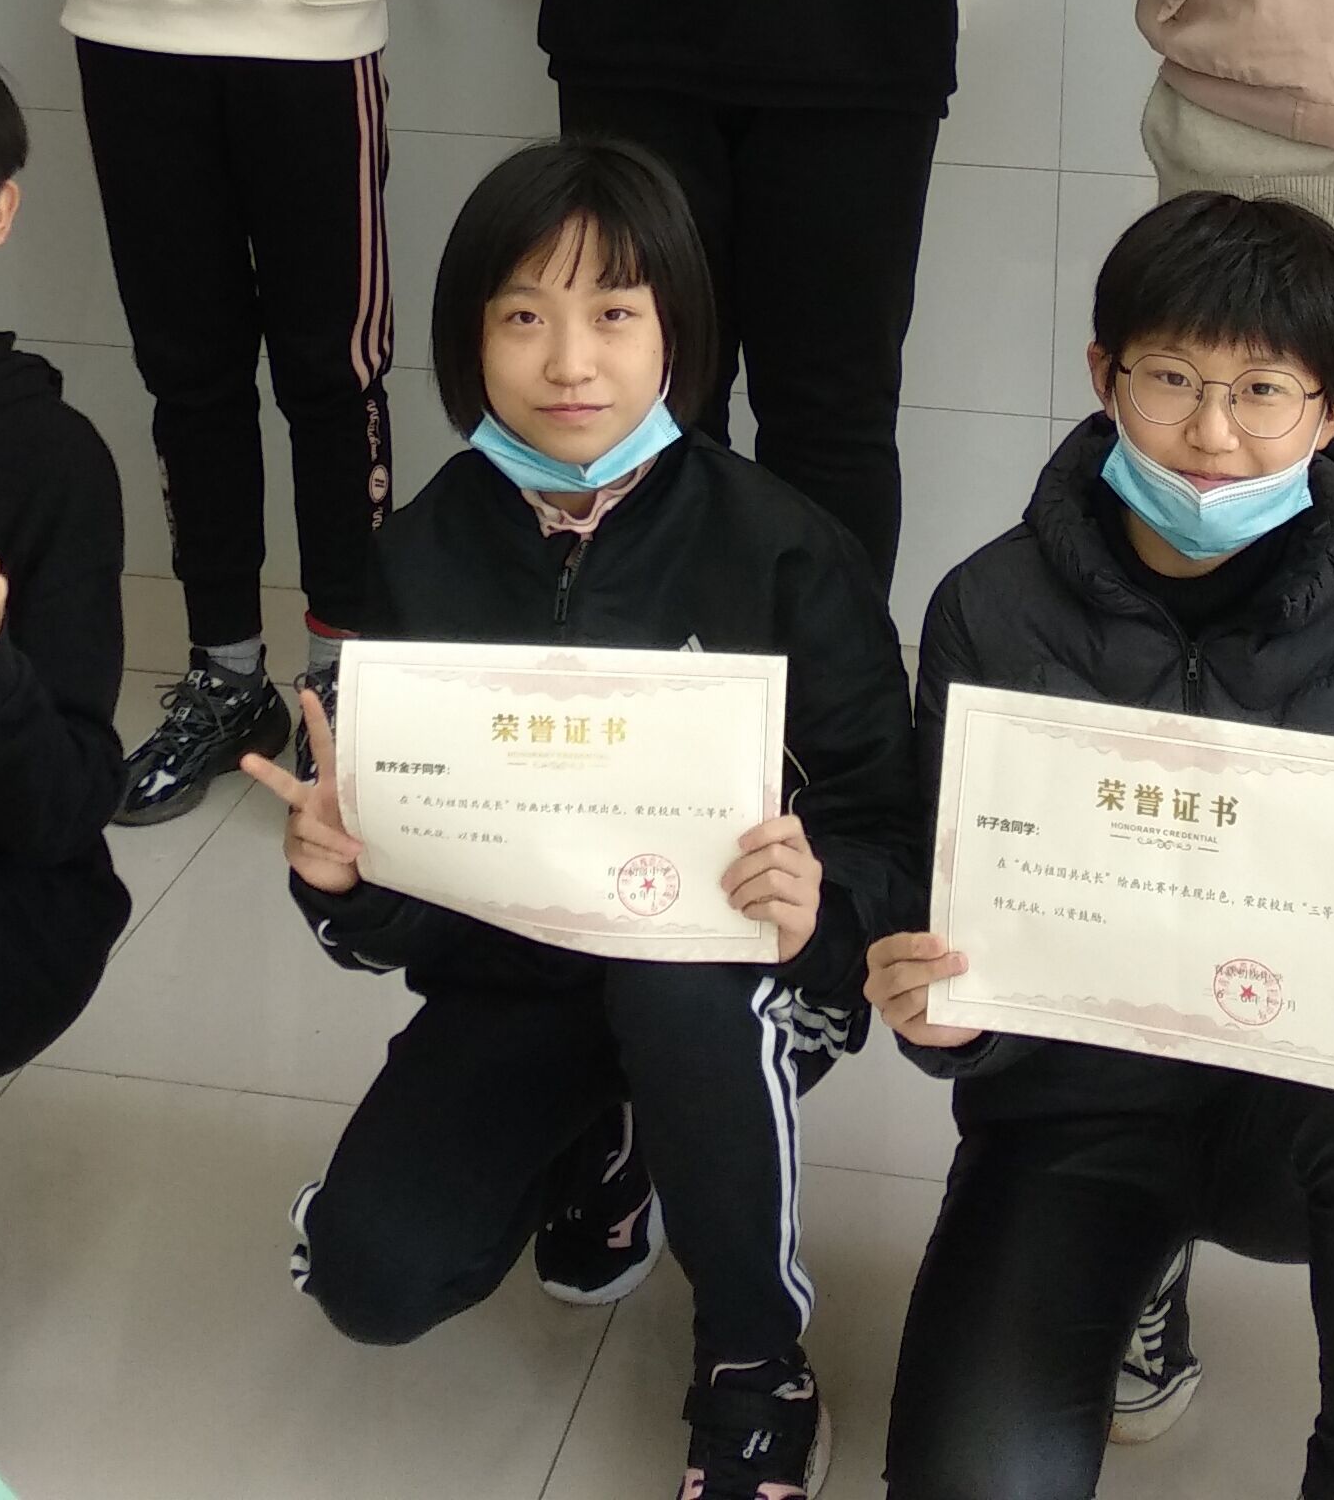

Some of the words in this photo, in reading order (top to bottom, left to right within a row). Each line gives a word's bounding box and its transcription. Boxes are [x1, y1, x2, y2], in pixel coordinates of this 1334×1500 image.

[491, 713, 627, 745] 荣誉证书
[1096, 778, 1240, 828] 荣誉证书
[975, 815, 1041, 836] 许子含同学:
[1110, 821, 1161, 836] HONORARY
[1162, 826, 1219, 844] CREDENTIAL
